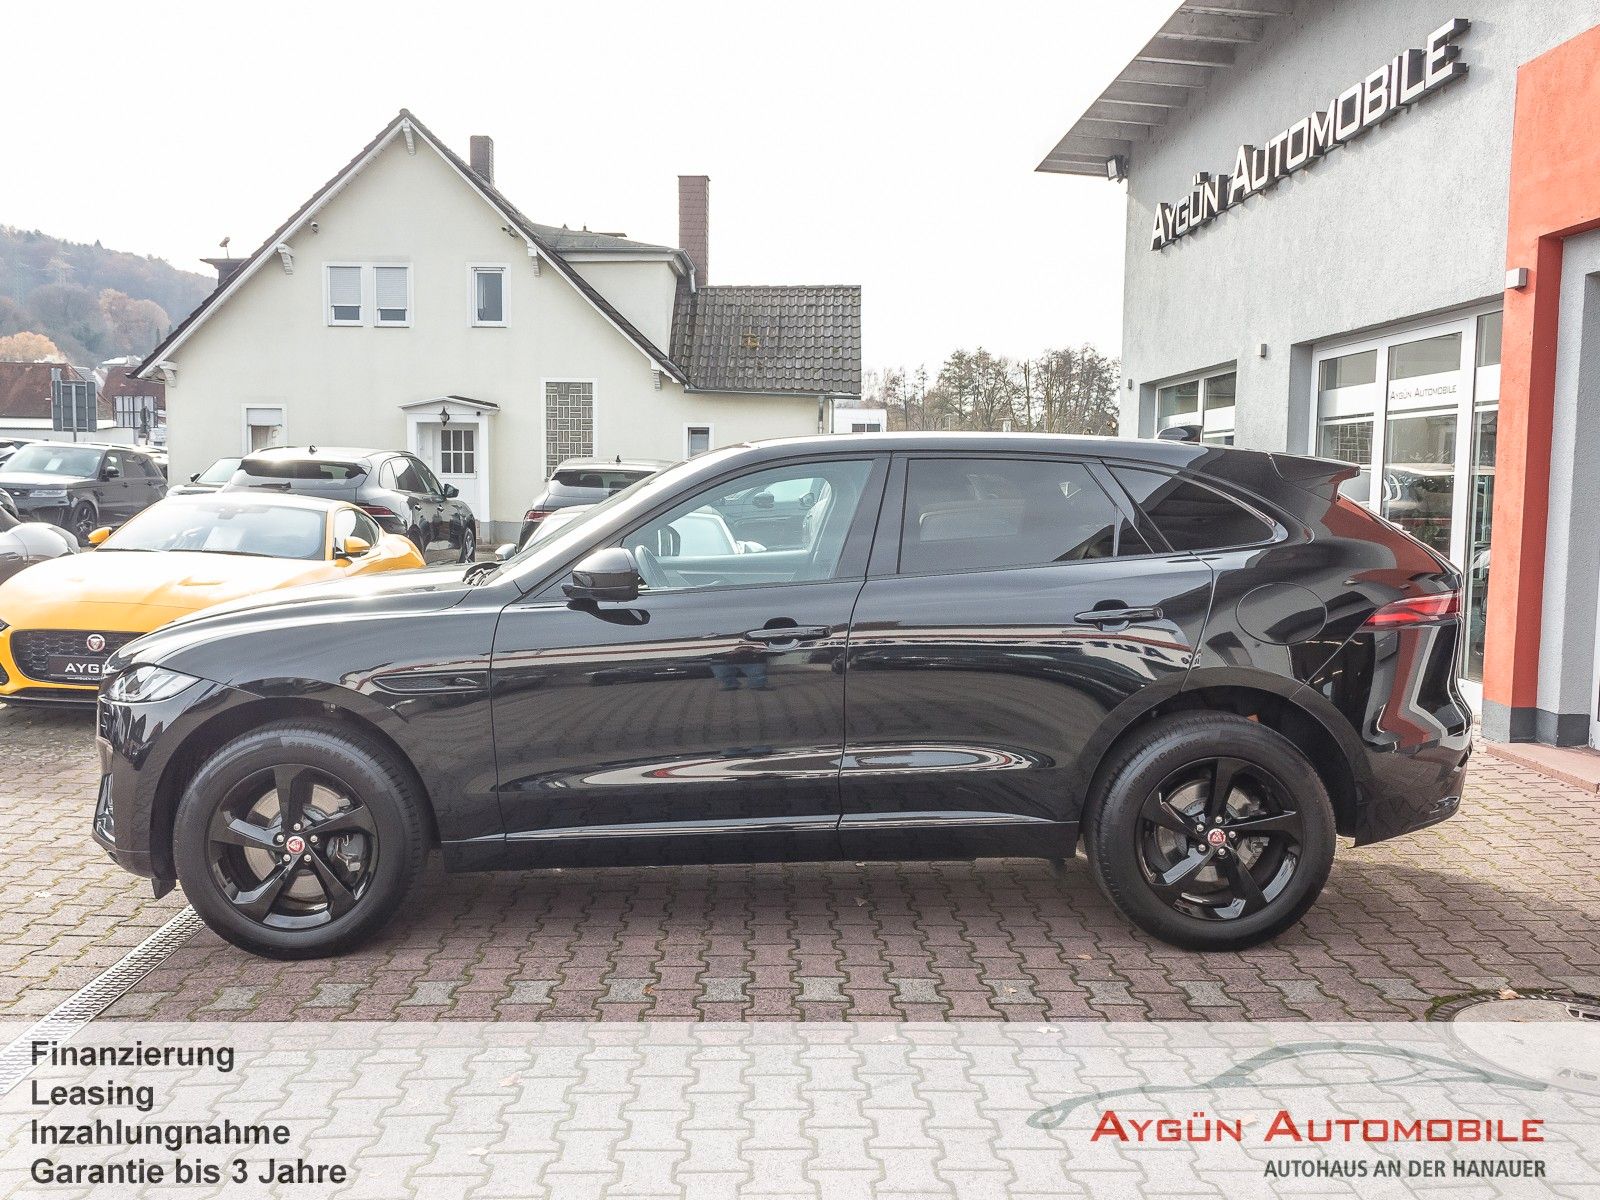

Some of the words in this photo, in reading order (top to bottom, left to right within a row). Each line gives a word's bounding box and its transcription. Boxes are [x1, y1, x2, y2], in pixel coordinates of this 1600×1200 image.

[1150, 171, 1226, 251] AYGÜN
[1228, 18, 1466, 206] AUTOMOBILE
[1414, 384, 1457, 397] AUTOMOBILE
[64, 662, 106, 674] AYG
